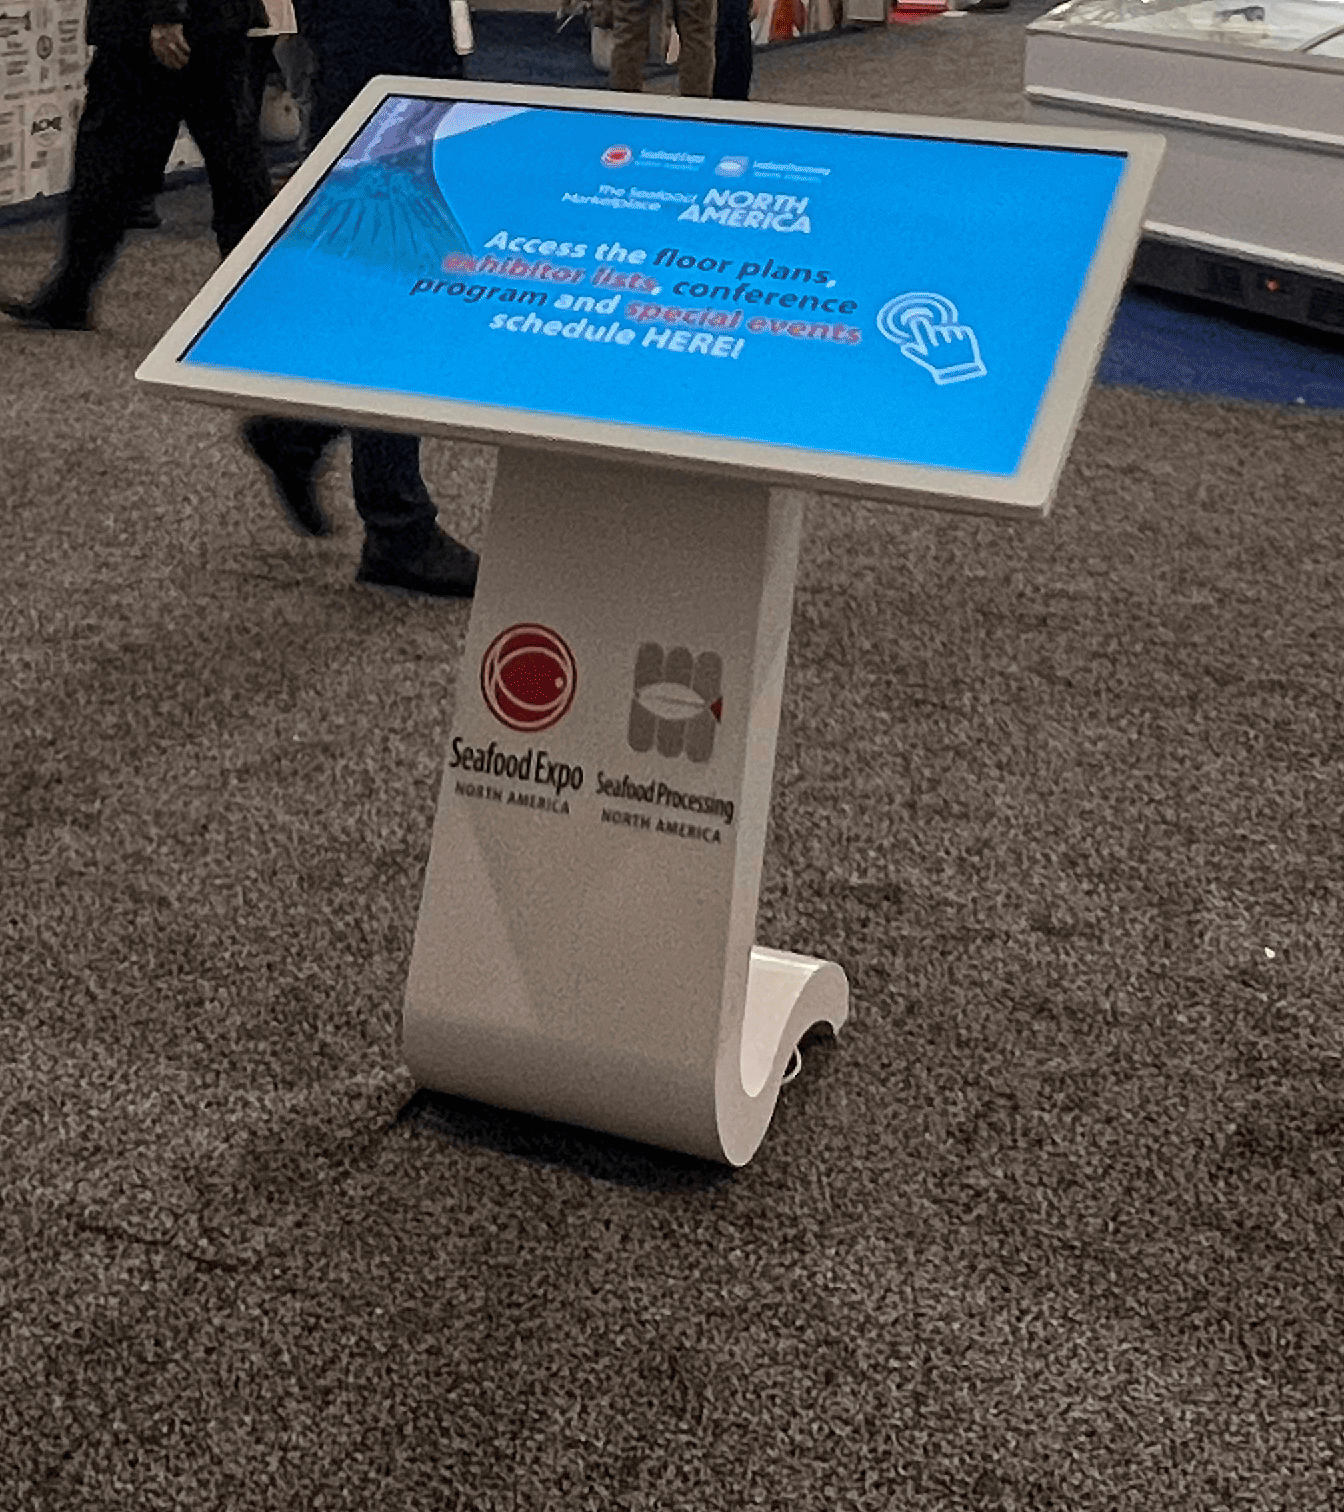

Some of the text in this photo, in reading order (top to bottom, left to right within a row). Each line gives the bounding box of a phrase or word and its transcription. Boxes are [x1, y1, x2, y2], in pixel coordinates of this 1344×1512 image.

[678, 205, 811, 233] AMERICA
[703, 188, 810, 214] NORTH
[484, 230, 837, 288] Access the floor plans,
[443, 254, 858, 316] exhibitor lists, conference
[409, 277, 862, 345] program and special events
[489, 312, 746, 360] schedule HERE!
[449, 736, 584, 794] Seafood Expo
[455, 781, 570, 814] NORTH AMERICA
[596, 770, 735, 825] Seafood Processing
[601, 808, 722, 844] NORTH AMERICA
